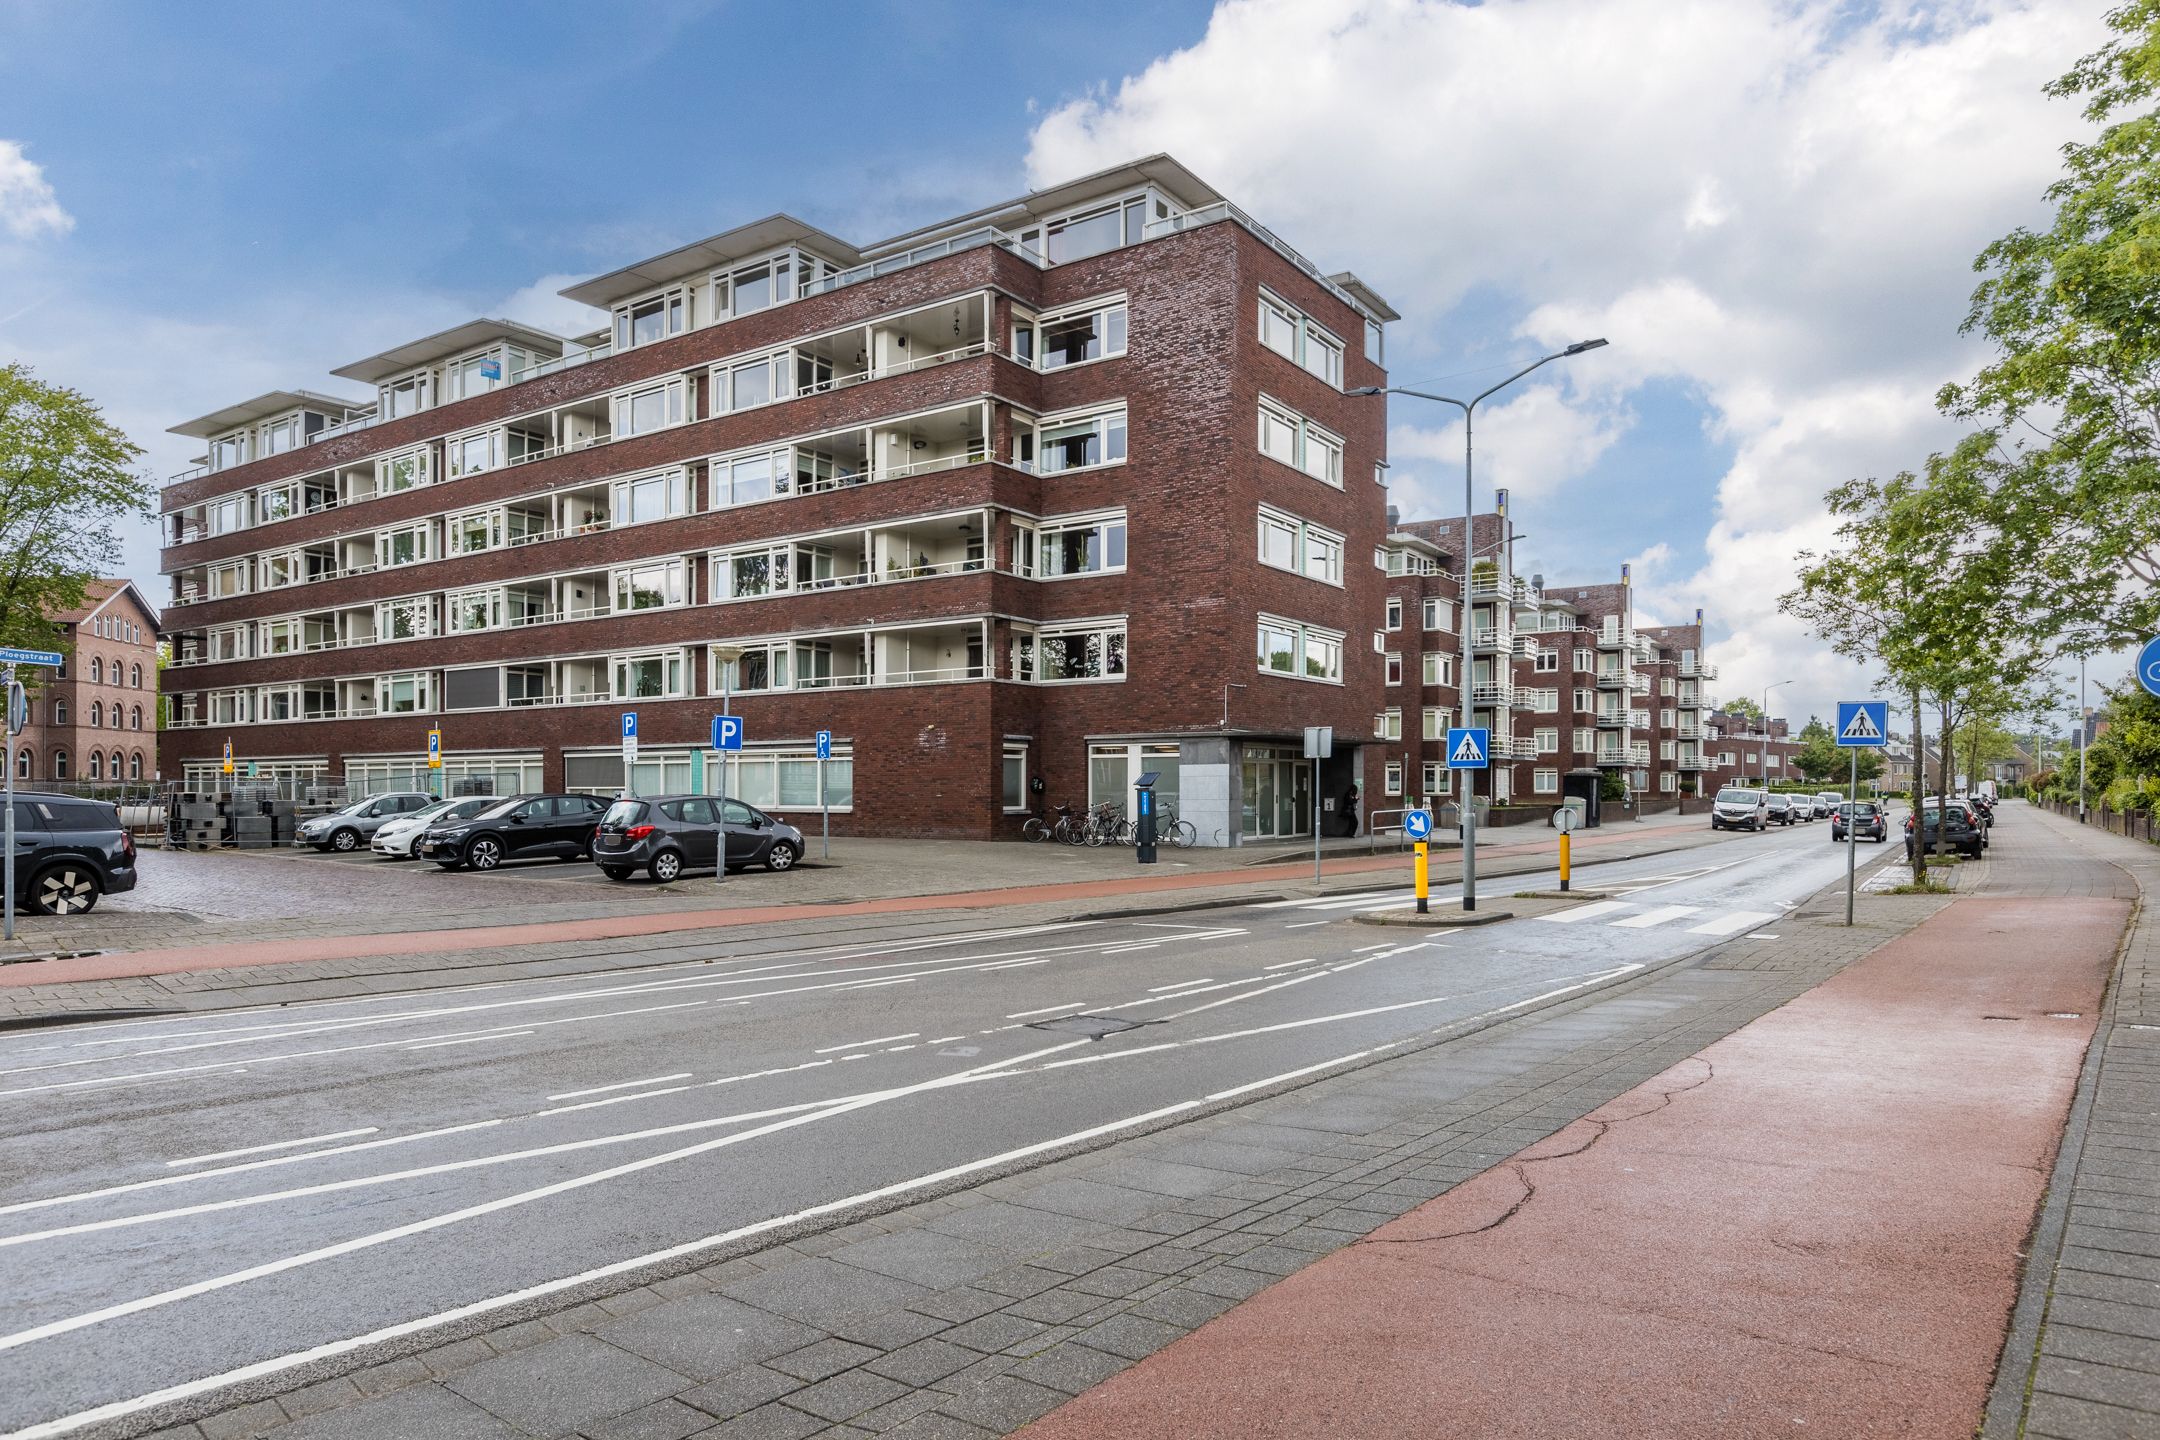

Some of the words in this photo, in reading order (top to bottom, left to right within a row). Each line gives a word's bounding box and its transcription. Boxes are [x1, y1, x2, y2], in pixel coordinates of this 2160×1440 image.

[625, 716, 634, 734] P
[721, 720, 737, 745] P
[431, 736, 437, 750] P
[819, 734, 828, 748] P
